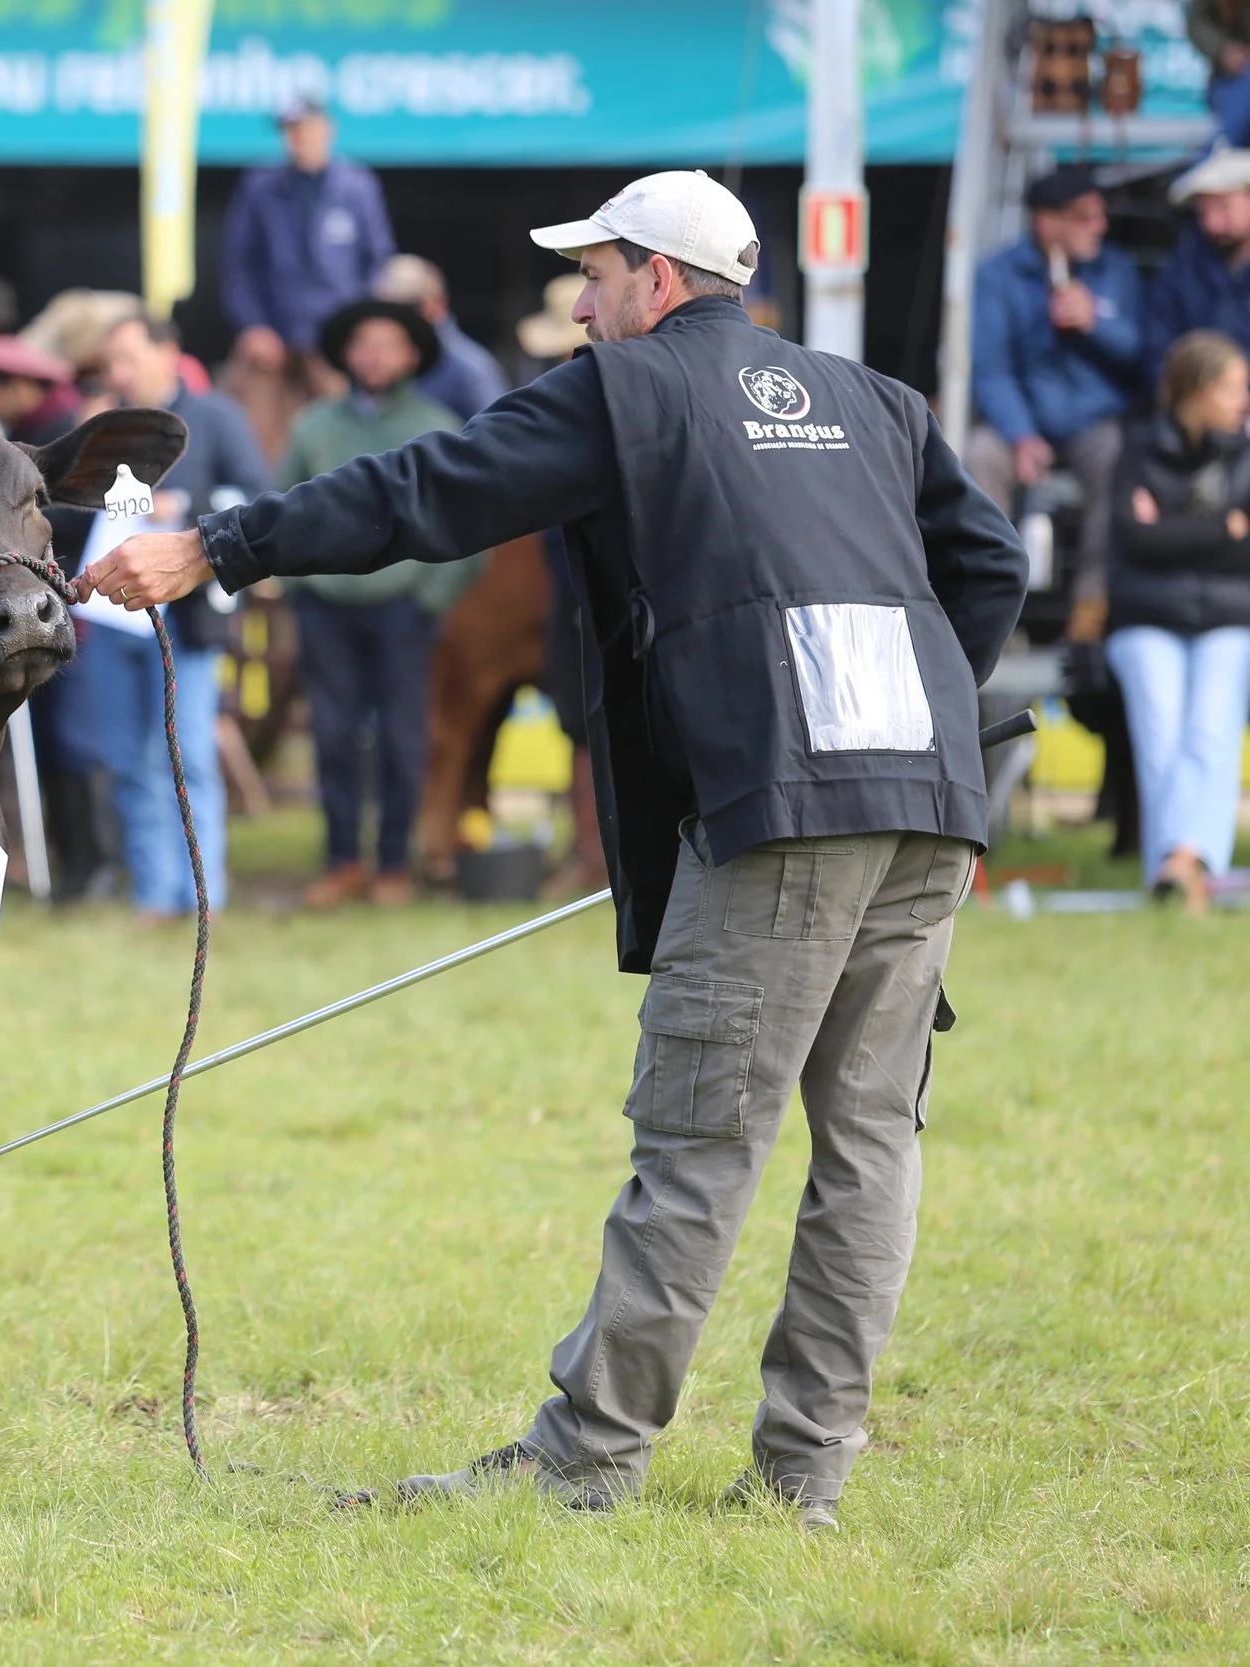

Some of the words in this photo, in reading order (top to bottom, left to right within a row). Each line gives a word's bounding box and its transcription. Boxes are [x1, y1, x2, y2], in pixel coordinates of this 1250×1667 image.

[338, 52, 592, 116] crescer.
[742, 420, 845, 442] Brangus
[106, 497, 150, 520] 5420
